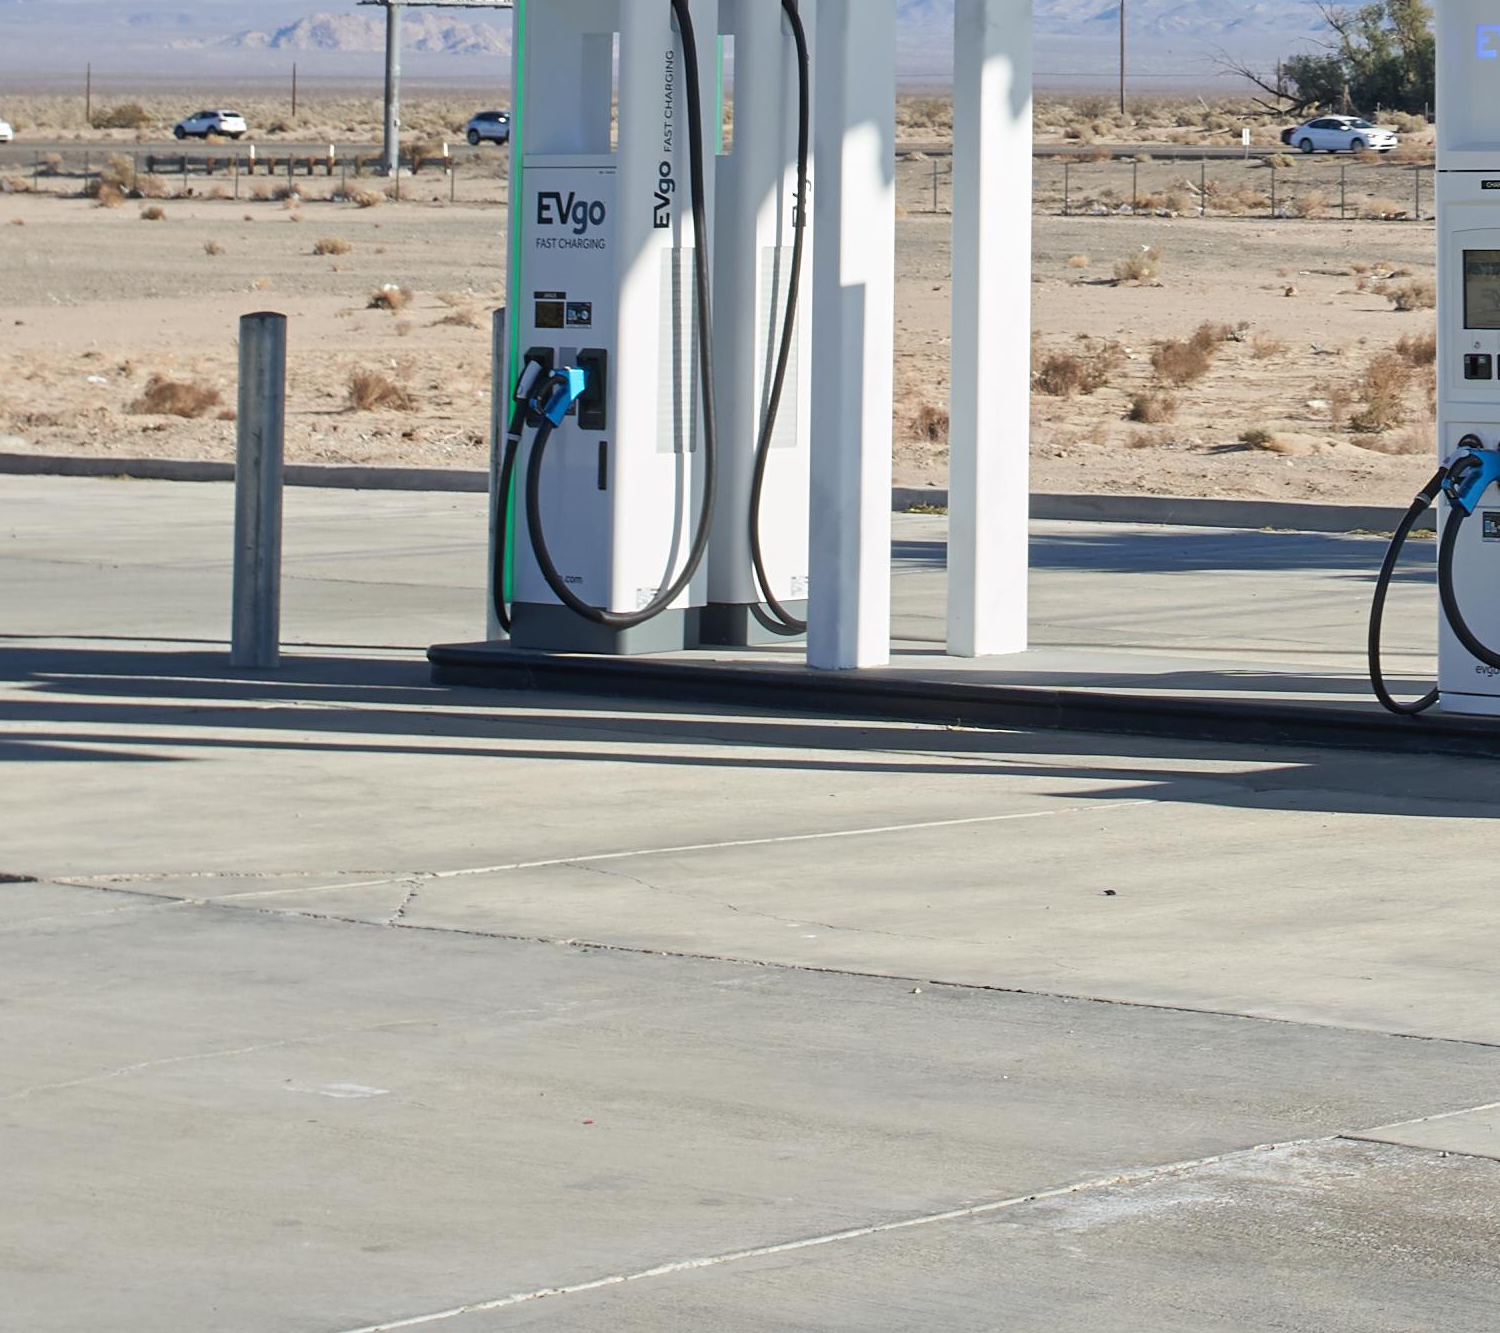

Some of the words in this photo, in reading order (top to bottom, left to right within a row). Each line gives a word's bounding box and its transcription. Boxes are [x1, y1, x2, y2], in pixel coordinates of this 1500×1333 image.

[664, 50, 674, 119] CHARGING
[663, 123, 673, 152] FAST
[537, 191, 606, 235] EVgo
[653, 161, 675, 228] EVgo
[536, 238, 556, 249] FAST
[558, 238, 606, 250] CHARGING
